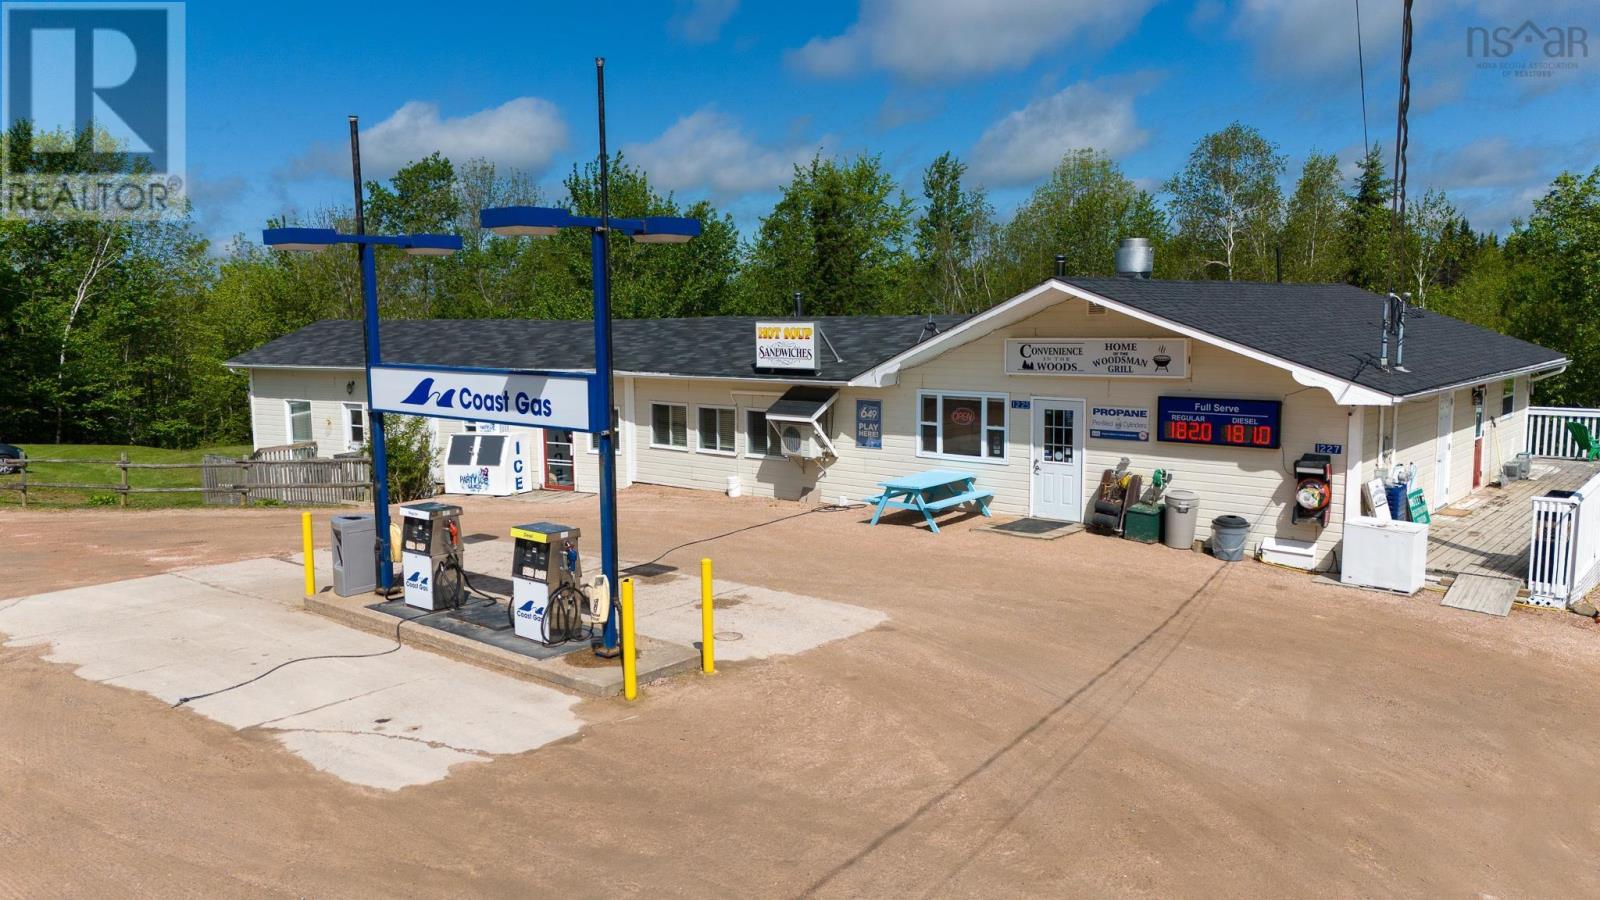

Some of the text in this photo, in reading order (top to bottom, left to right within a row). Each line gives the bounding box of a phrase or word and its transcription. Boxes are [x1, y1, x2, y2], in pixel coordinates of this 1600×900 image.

[758, 327, 812, 339] HOT SOUP
[1020, 344, 1083, 358] CONVENIENCE
[1104, 342, 1137, 351] HOME
[759, 345, 813, 360] SANDWICHES
[1092, 355, 1148, 367] WOODSMAN
[1037, 362, 1078, 371] WOODS
[1107, 364, 1134, 373] GRILL
[459, 387, 552, 417] Coast Gas
[861, 407, 878, 418] 649
[1194, 403, 1240, 413] Full Serve
[1092, 408, 1147, 418] PROPANE
[1171, 414, 1206, 422] REGULAR
[1232, 417, 1258, 425] DIESEL
[858, 423, 878, 431] PLAY
[1317, 445, 1340, 454] 1227
[516, 611, 532, 620] Coast
